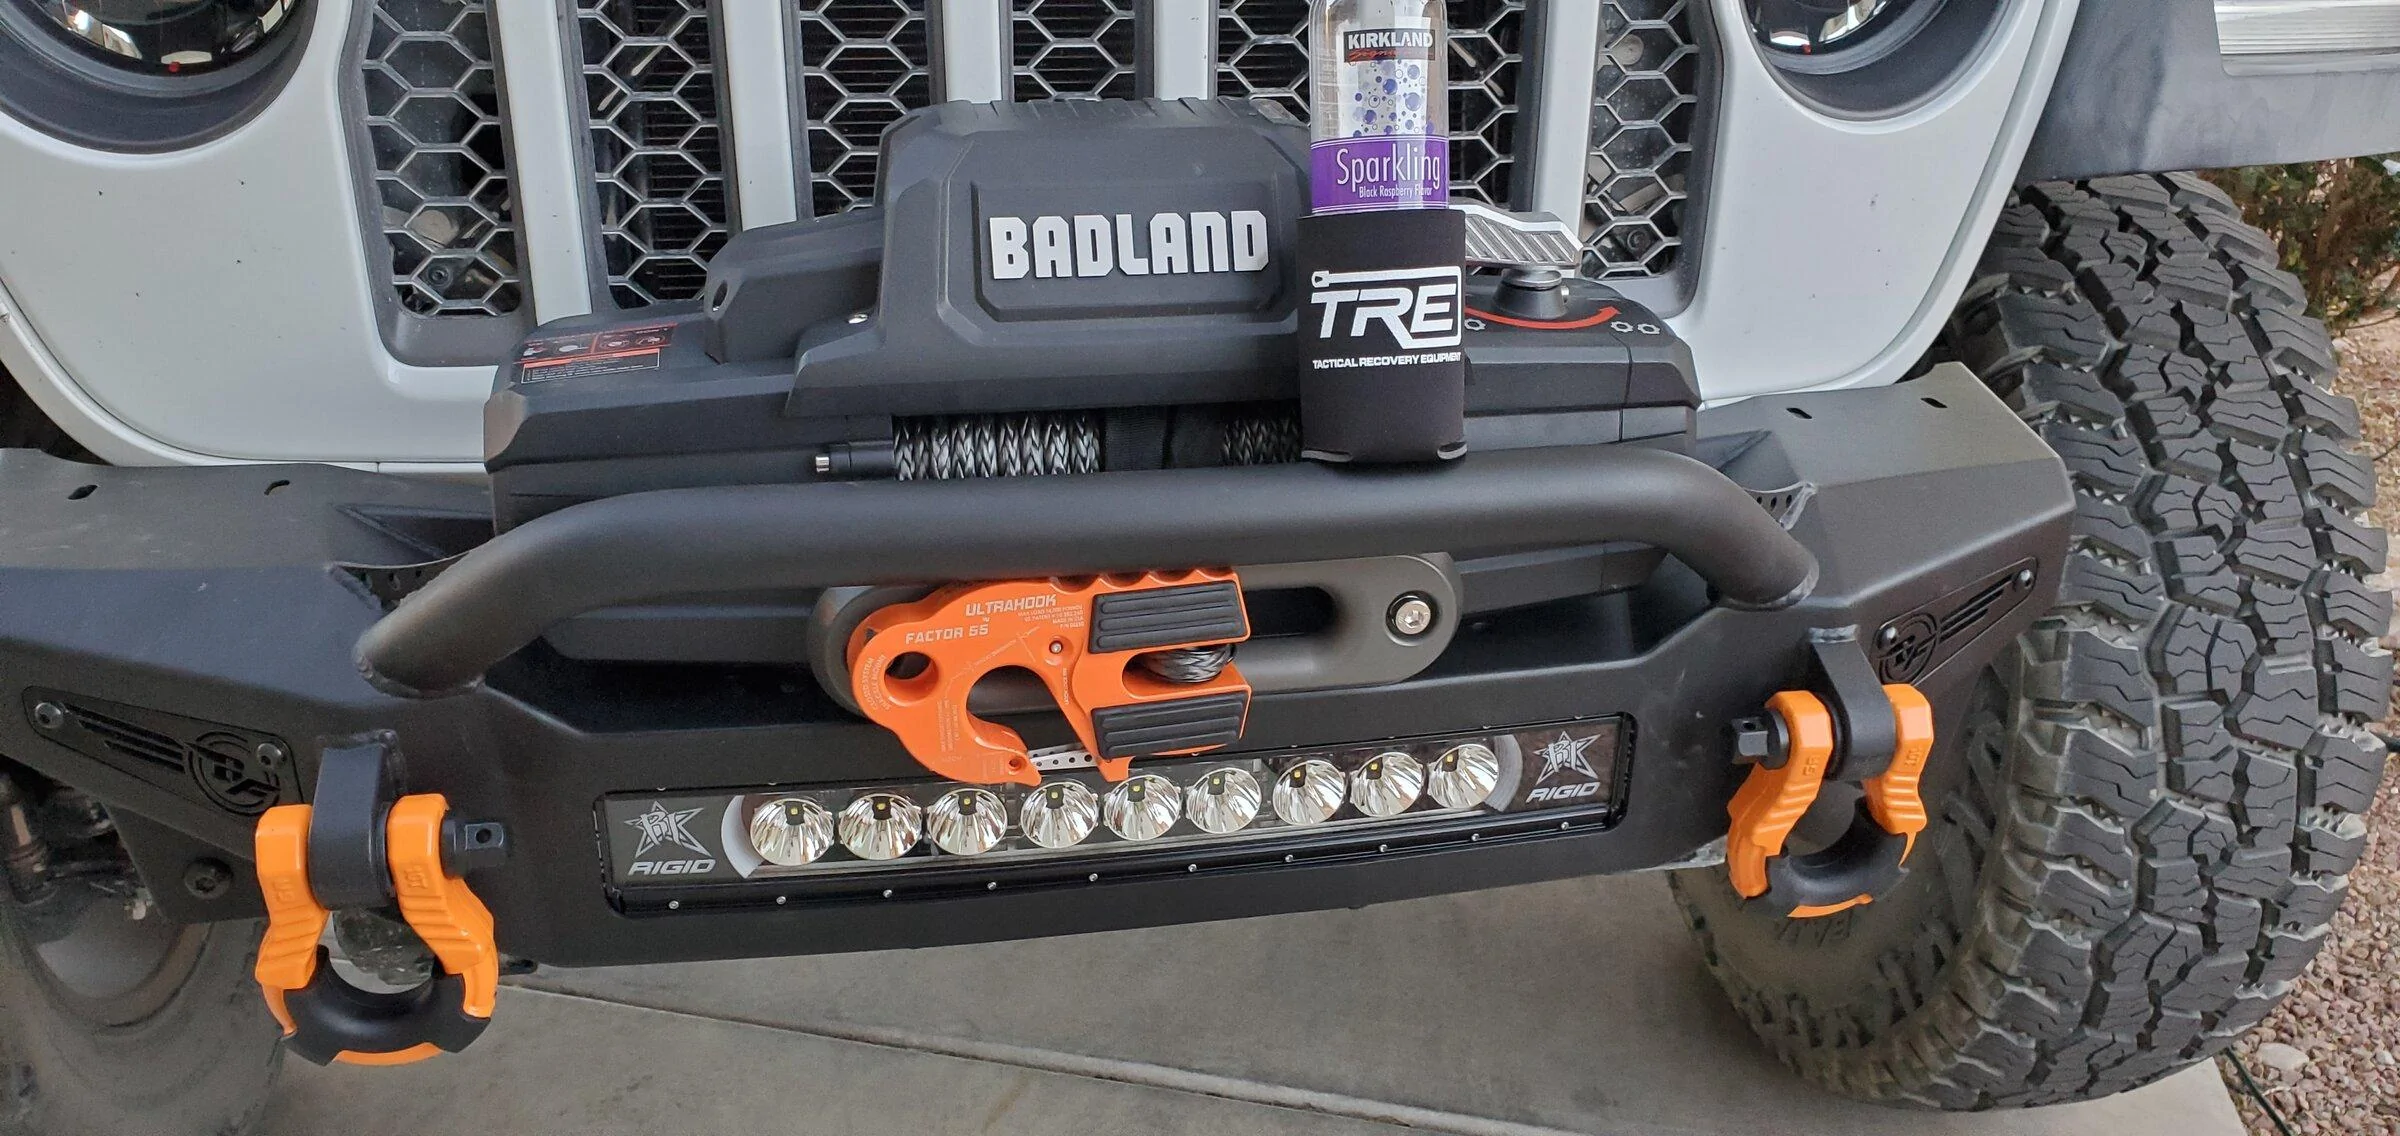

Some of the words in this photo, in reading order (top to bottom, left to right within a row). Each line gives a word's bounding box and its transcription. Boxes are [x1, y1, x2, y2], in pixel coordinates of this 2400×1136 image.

[1348, 31, 1433, 49] KIRKLAND
[1336, 143, 1440, 192] Sparkling
[1360, 186, 1378, 198] Black
[1380, 185, 1412, 199] Raspberry
[989, 210, 1270, 280] BADLAND
[1311, 278, 1461, 349] TRE
[1312, 359, 1358, 370] TACTICAL
[1359, 354, 1420, 367] RECOVERY
[1421, 351, 1462, 364] EQUIPMENT
[965, 593, 1057, 617] ULTRAHOOK
[905, 627, 963, 645] FACTOR
[968, 624, 989, 637] 55
[1525, 781, 1601, 804] RIGID
[627, 859, 716, 876] RIGID
